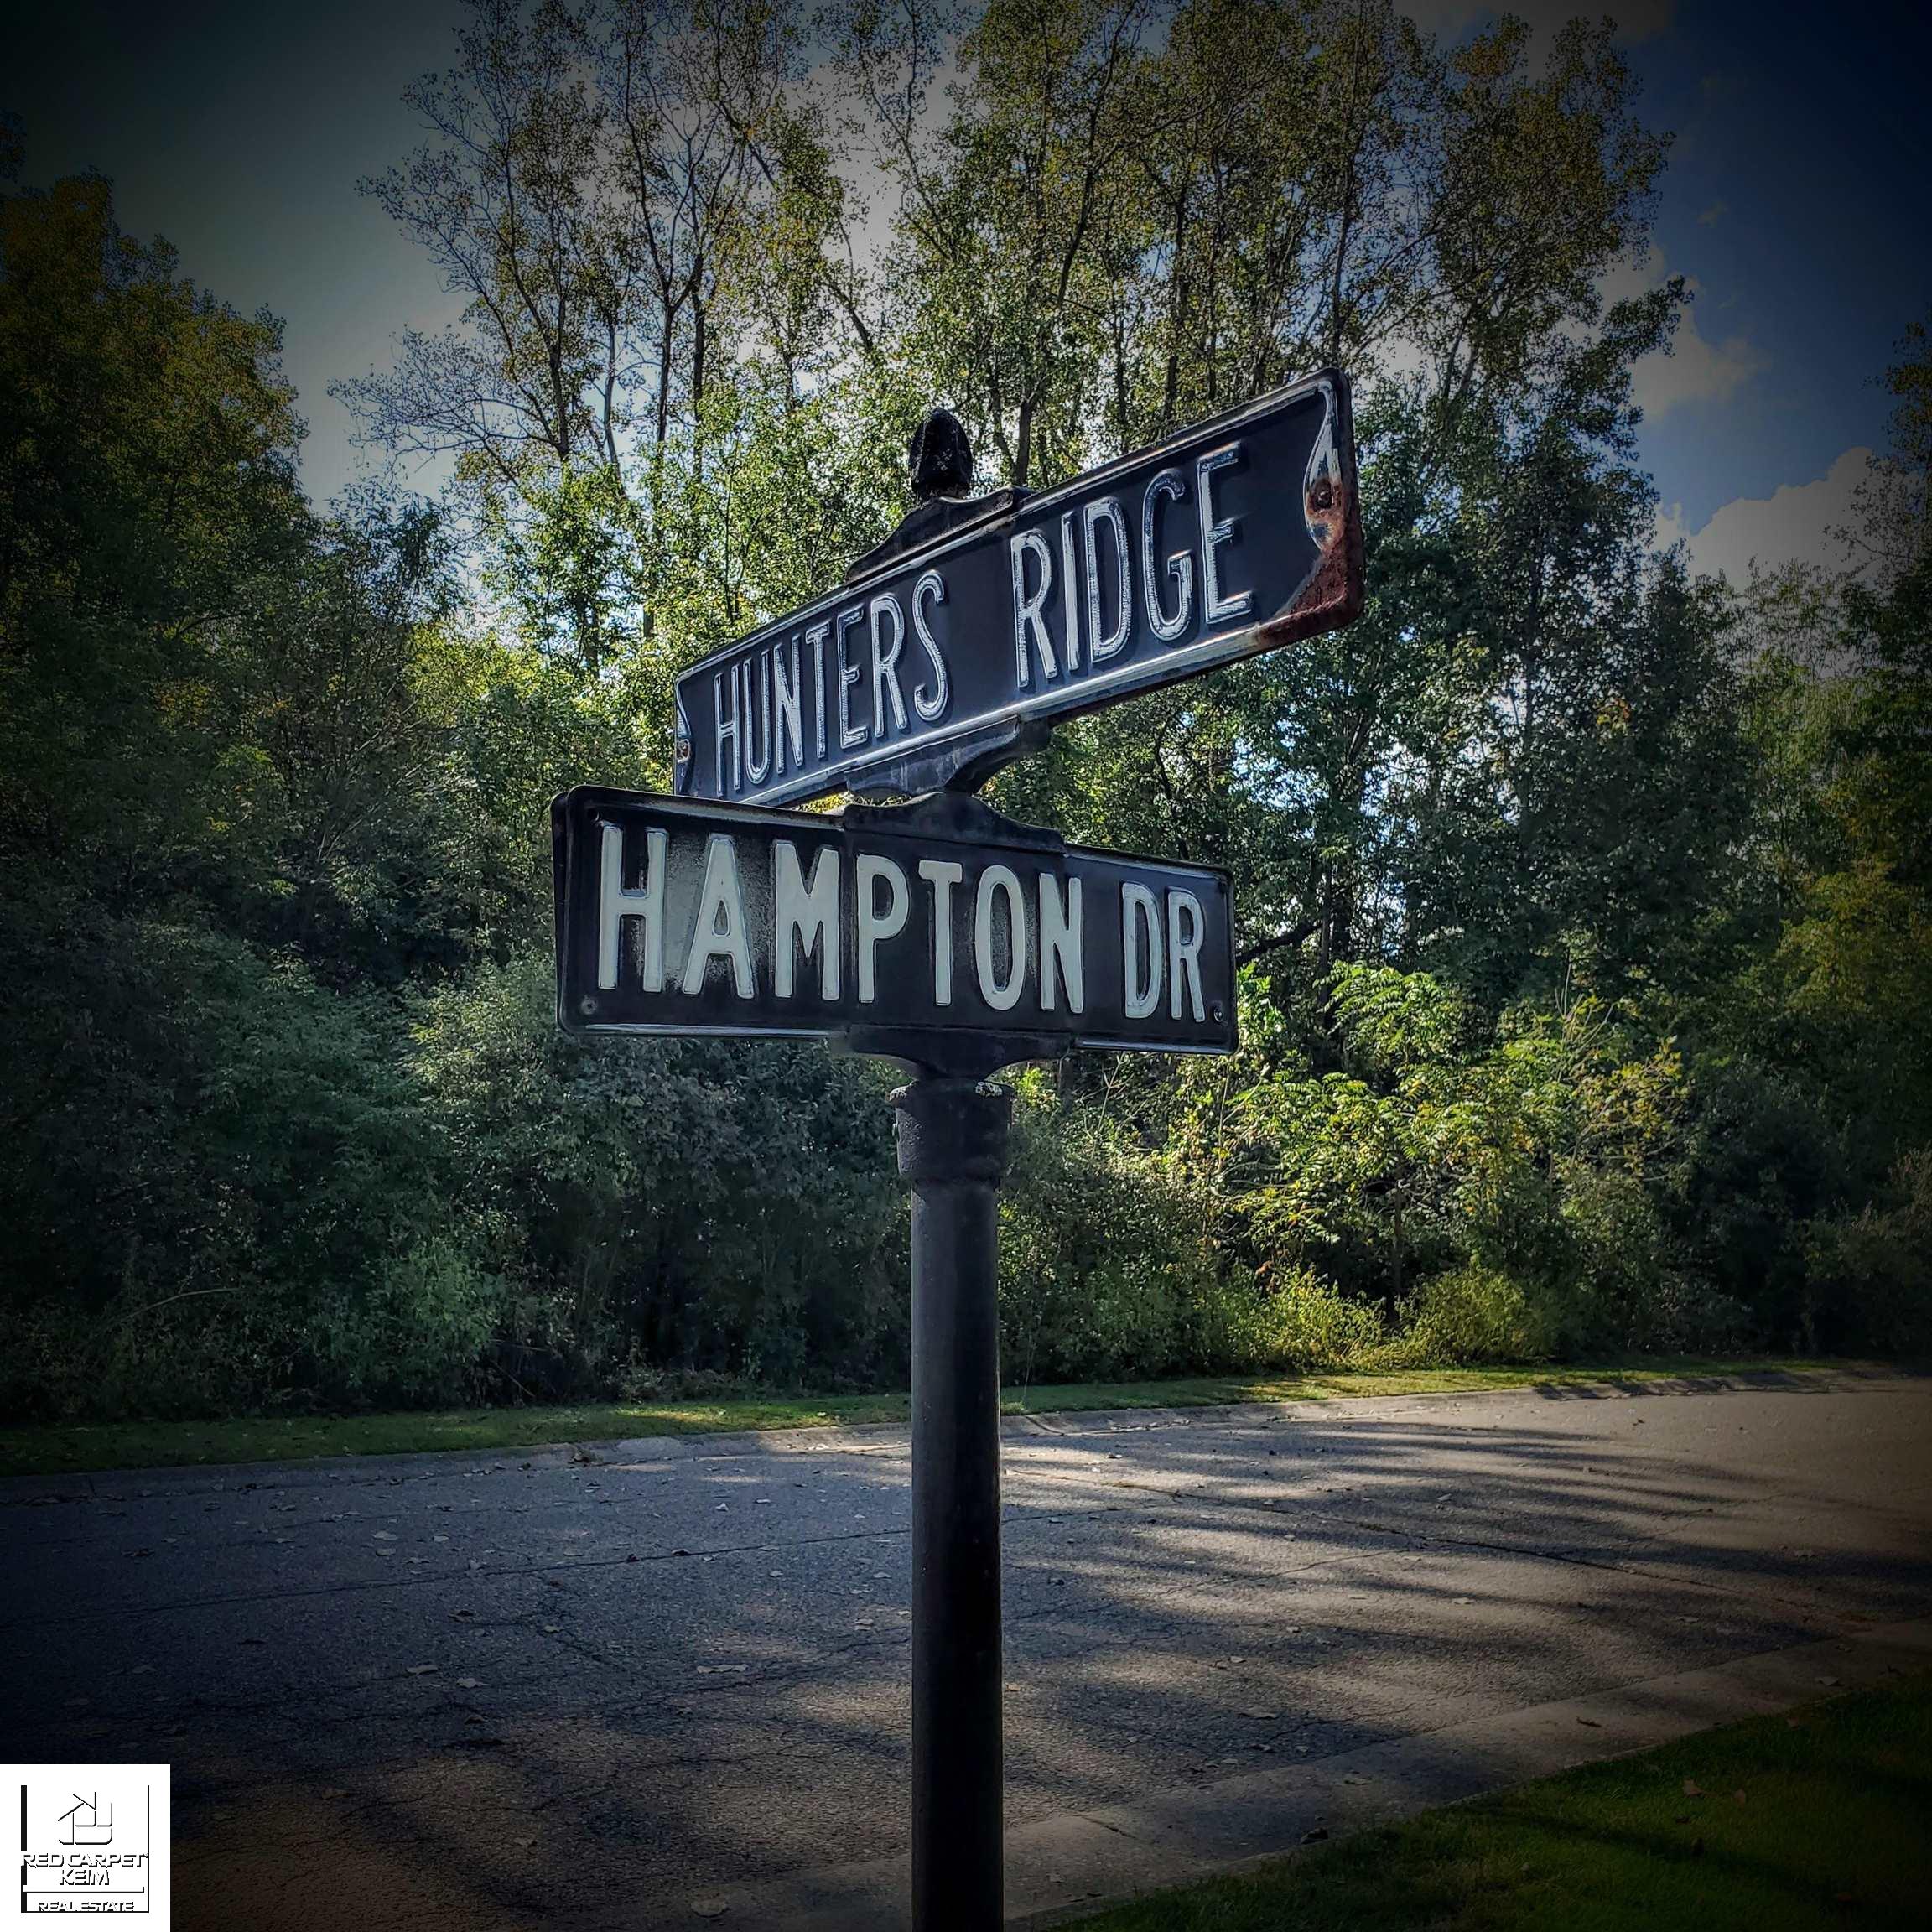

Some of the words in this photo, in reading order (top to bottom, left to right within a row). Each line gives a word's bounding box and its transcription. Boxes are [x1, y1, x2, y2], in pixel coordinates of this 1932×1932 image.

[714, 569, 949, 797] HUNTERS
[1010, 441, 1253, 688] RIDGE
[597, 820, 1084, 1013] HAMPTON
[1121, 881, 1206, 1022] DR
